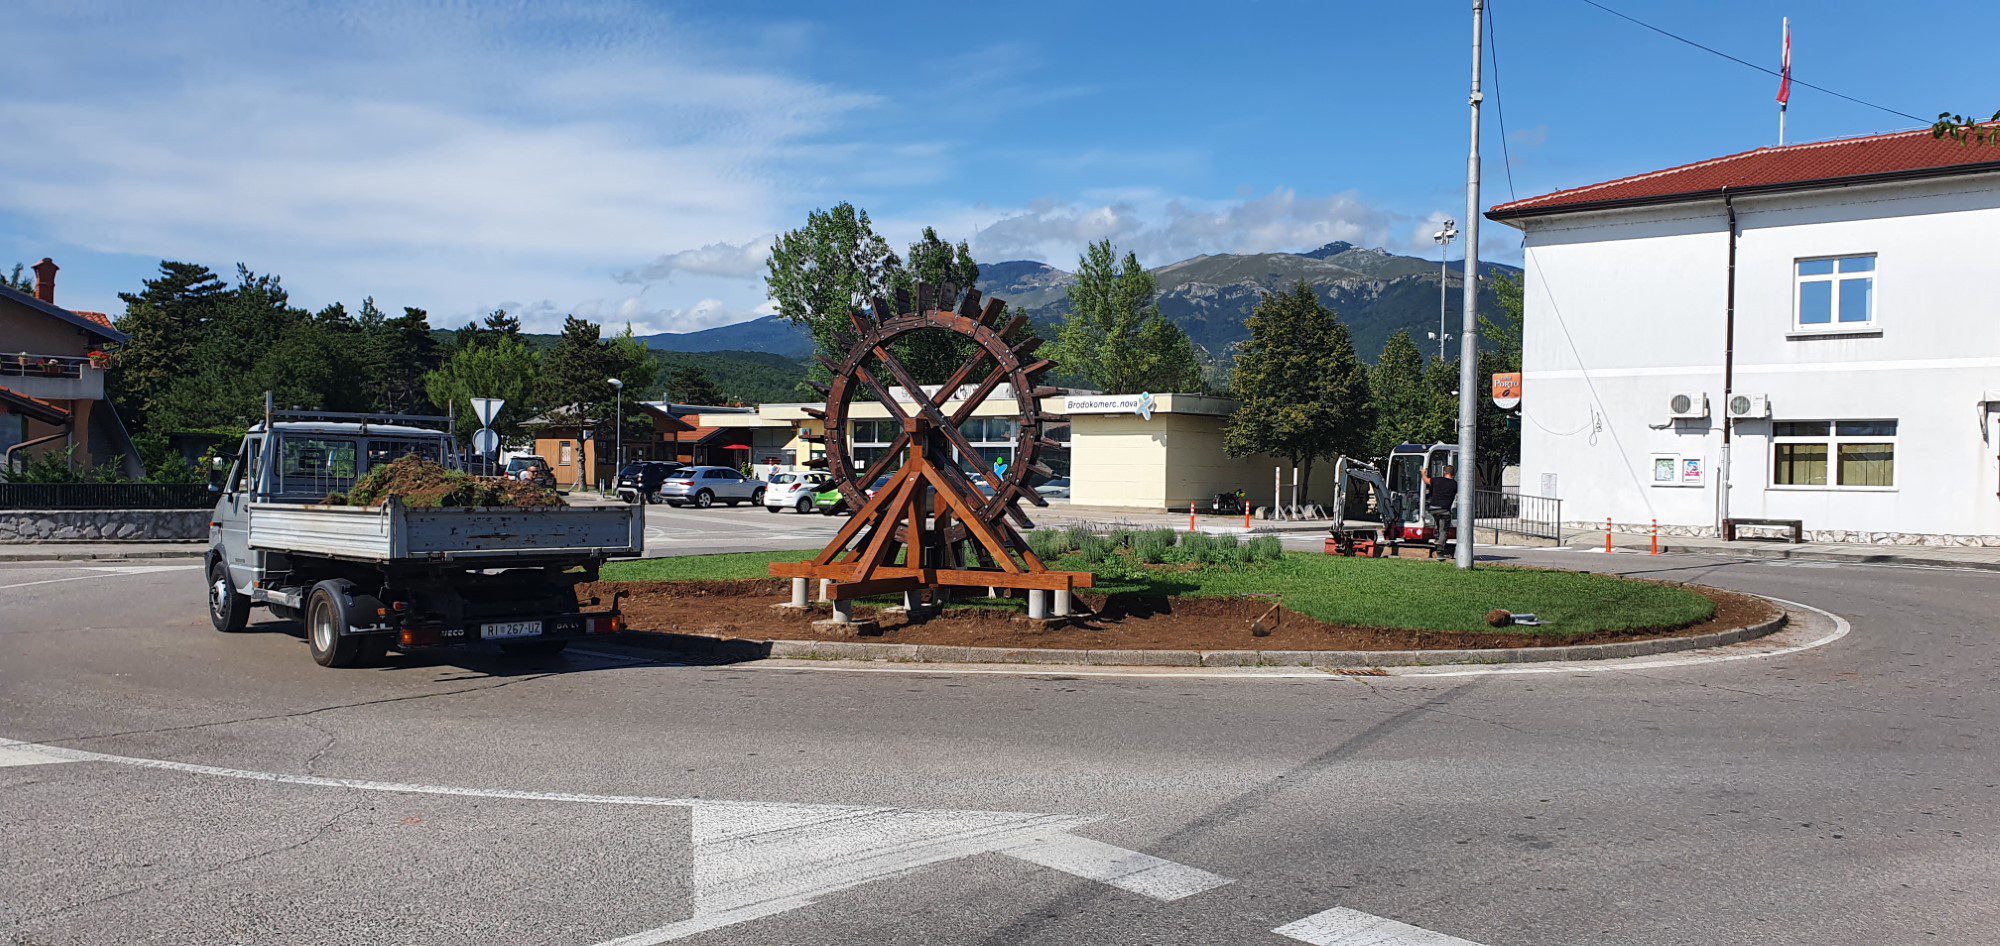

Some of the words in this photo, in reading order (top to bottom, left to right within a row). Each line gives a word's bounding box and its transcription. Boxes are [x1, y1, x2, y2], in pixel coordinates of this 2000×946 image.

[1067, 400, 1138, 409] Brodokomerc.nova
[487, 625, 498, 636] RI
[507, 622, 540, 635] 267-UZ
